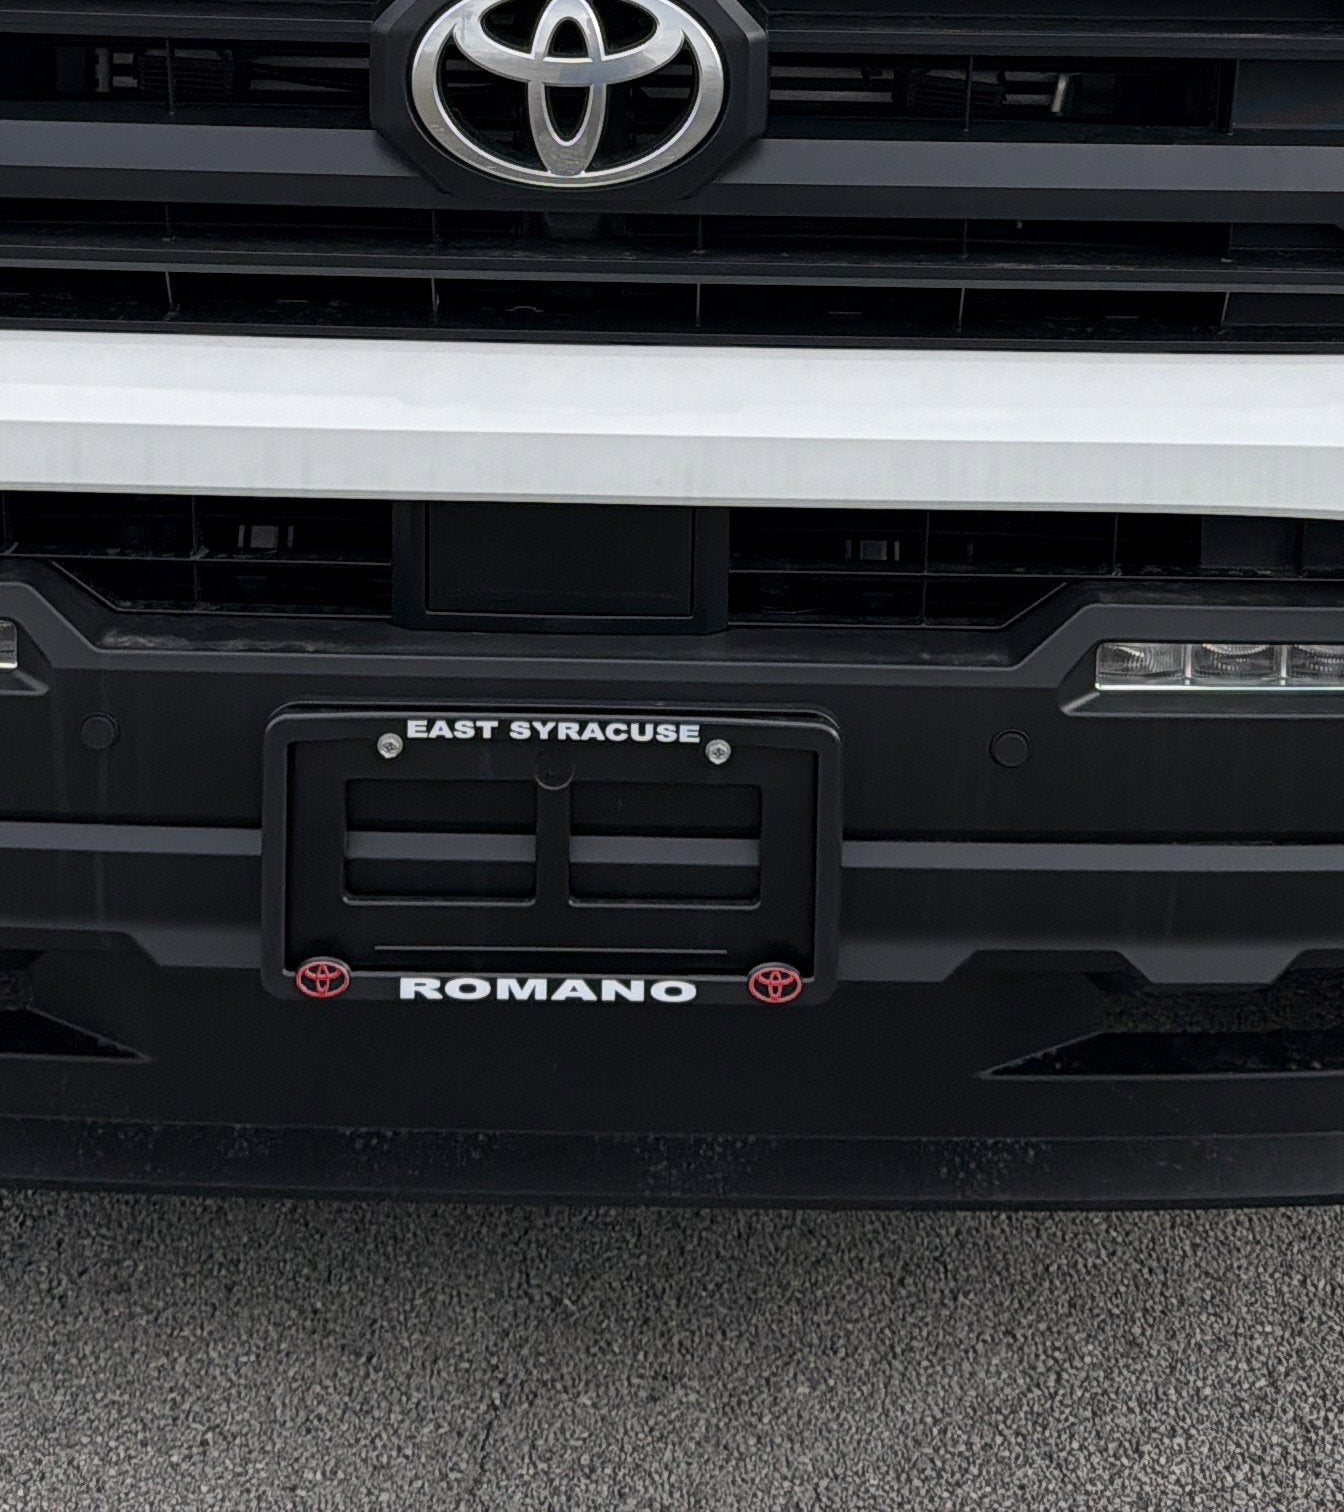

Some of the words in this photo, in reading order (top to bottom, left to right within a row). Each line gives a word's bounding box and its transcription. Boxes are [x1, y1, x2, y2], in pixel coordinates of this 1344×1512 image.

[406, 719, 499, 740] EAST
[509, 720, 701, 744] SYRACUSE
[399, 976, 697, 1003] ROMANO
